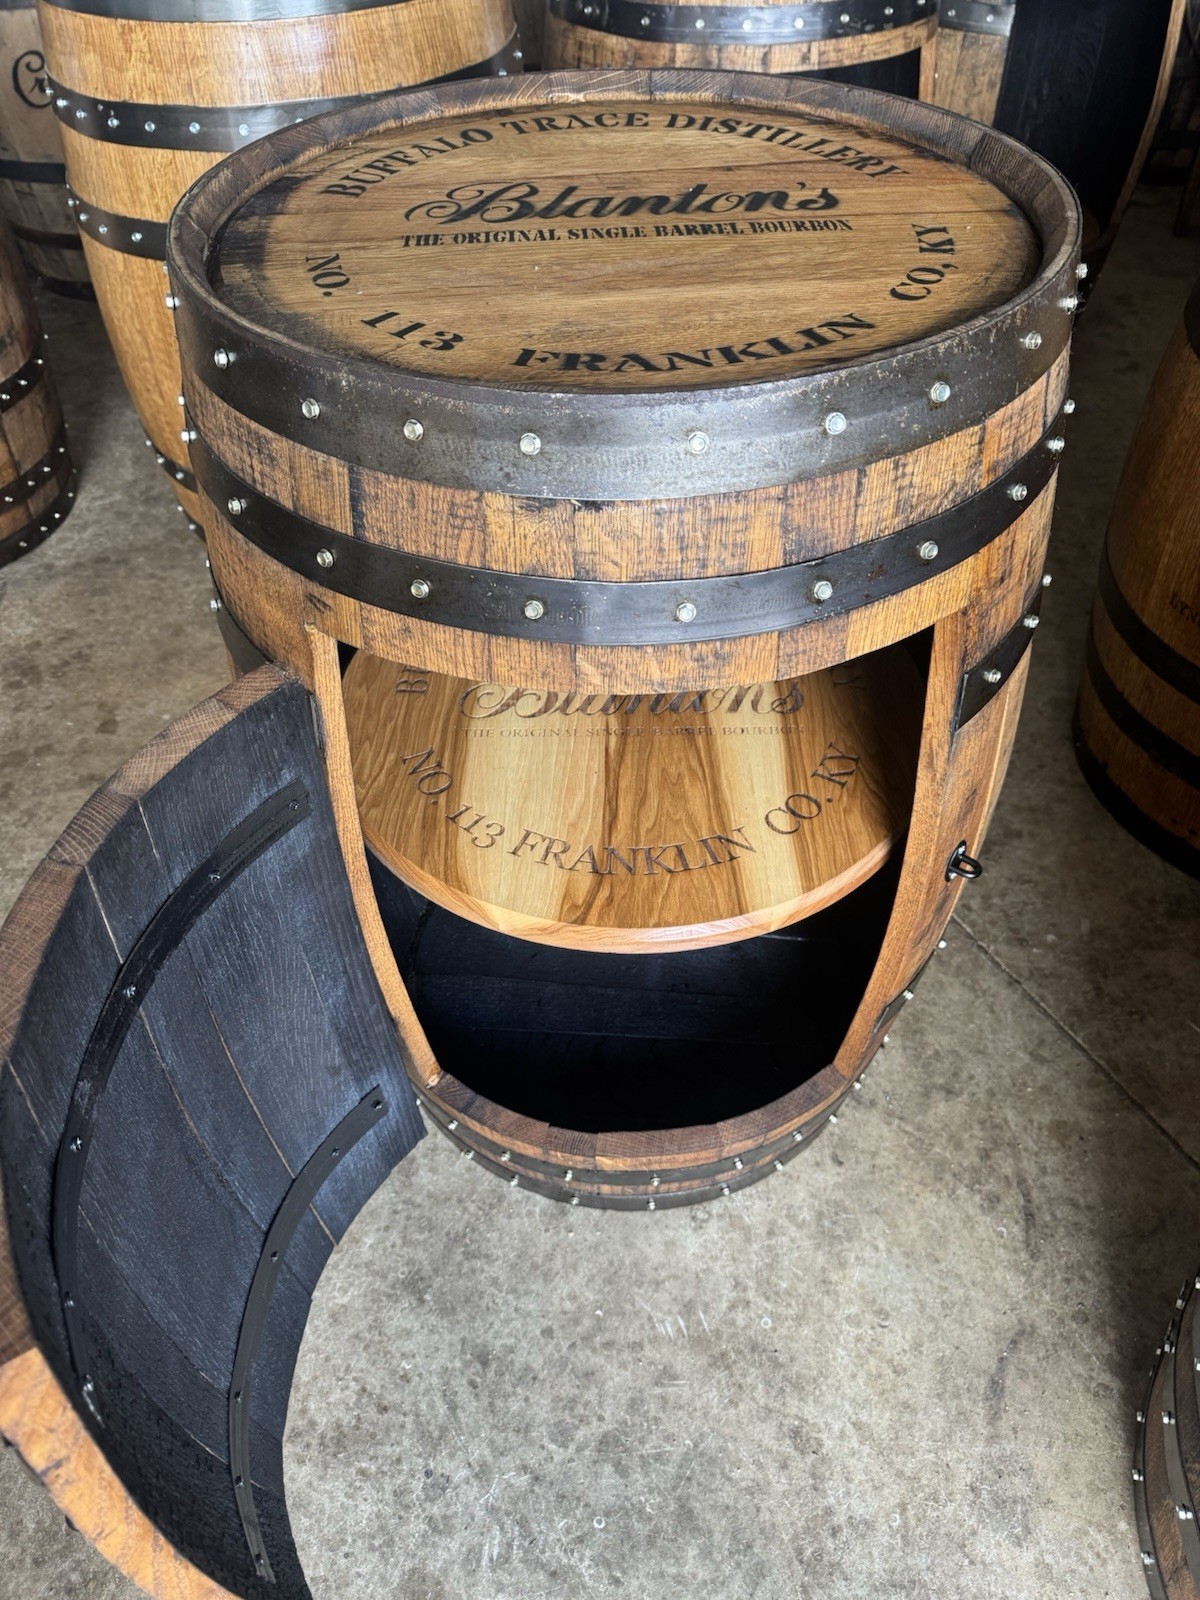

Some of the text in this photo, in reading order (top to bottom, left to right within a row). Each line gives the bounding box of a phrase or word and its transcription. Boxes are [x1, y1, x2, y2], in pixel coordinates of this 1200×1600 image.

[318, 112, 911, 199] BUFFALO TRACE DISTILLERY
[401, 219, 854, 248] THE ORIGINAL SINGLE BARREL BOURBON
[404, 181, 840, 225] Blanton's
[305, 252, 351, 298] NO.
[360, 309, 465, 351] 113
[509, 312, 876, 373] FRANKLIN
[911, 223, 955, 256] KY
[463, 723, 804, 739] THE ORIGINAL SINGLE BARREL BOURBON
[400, 741, 861, 876] NO. 113 FRANKLIN CO. KY
